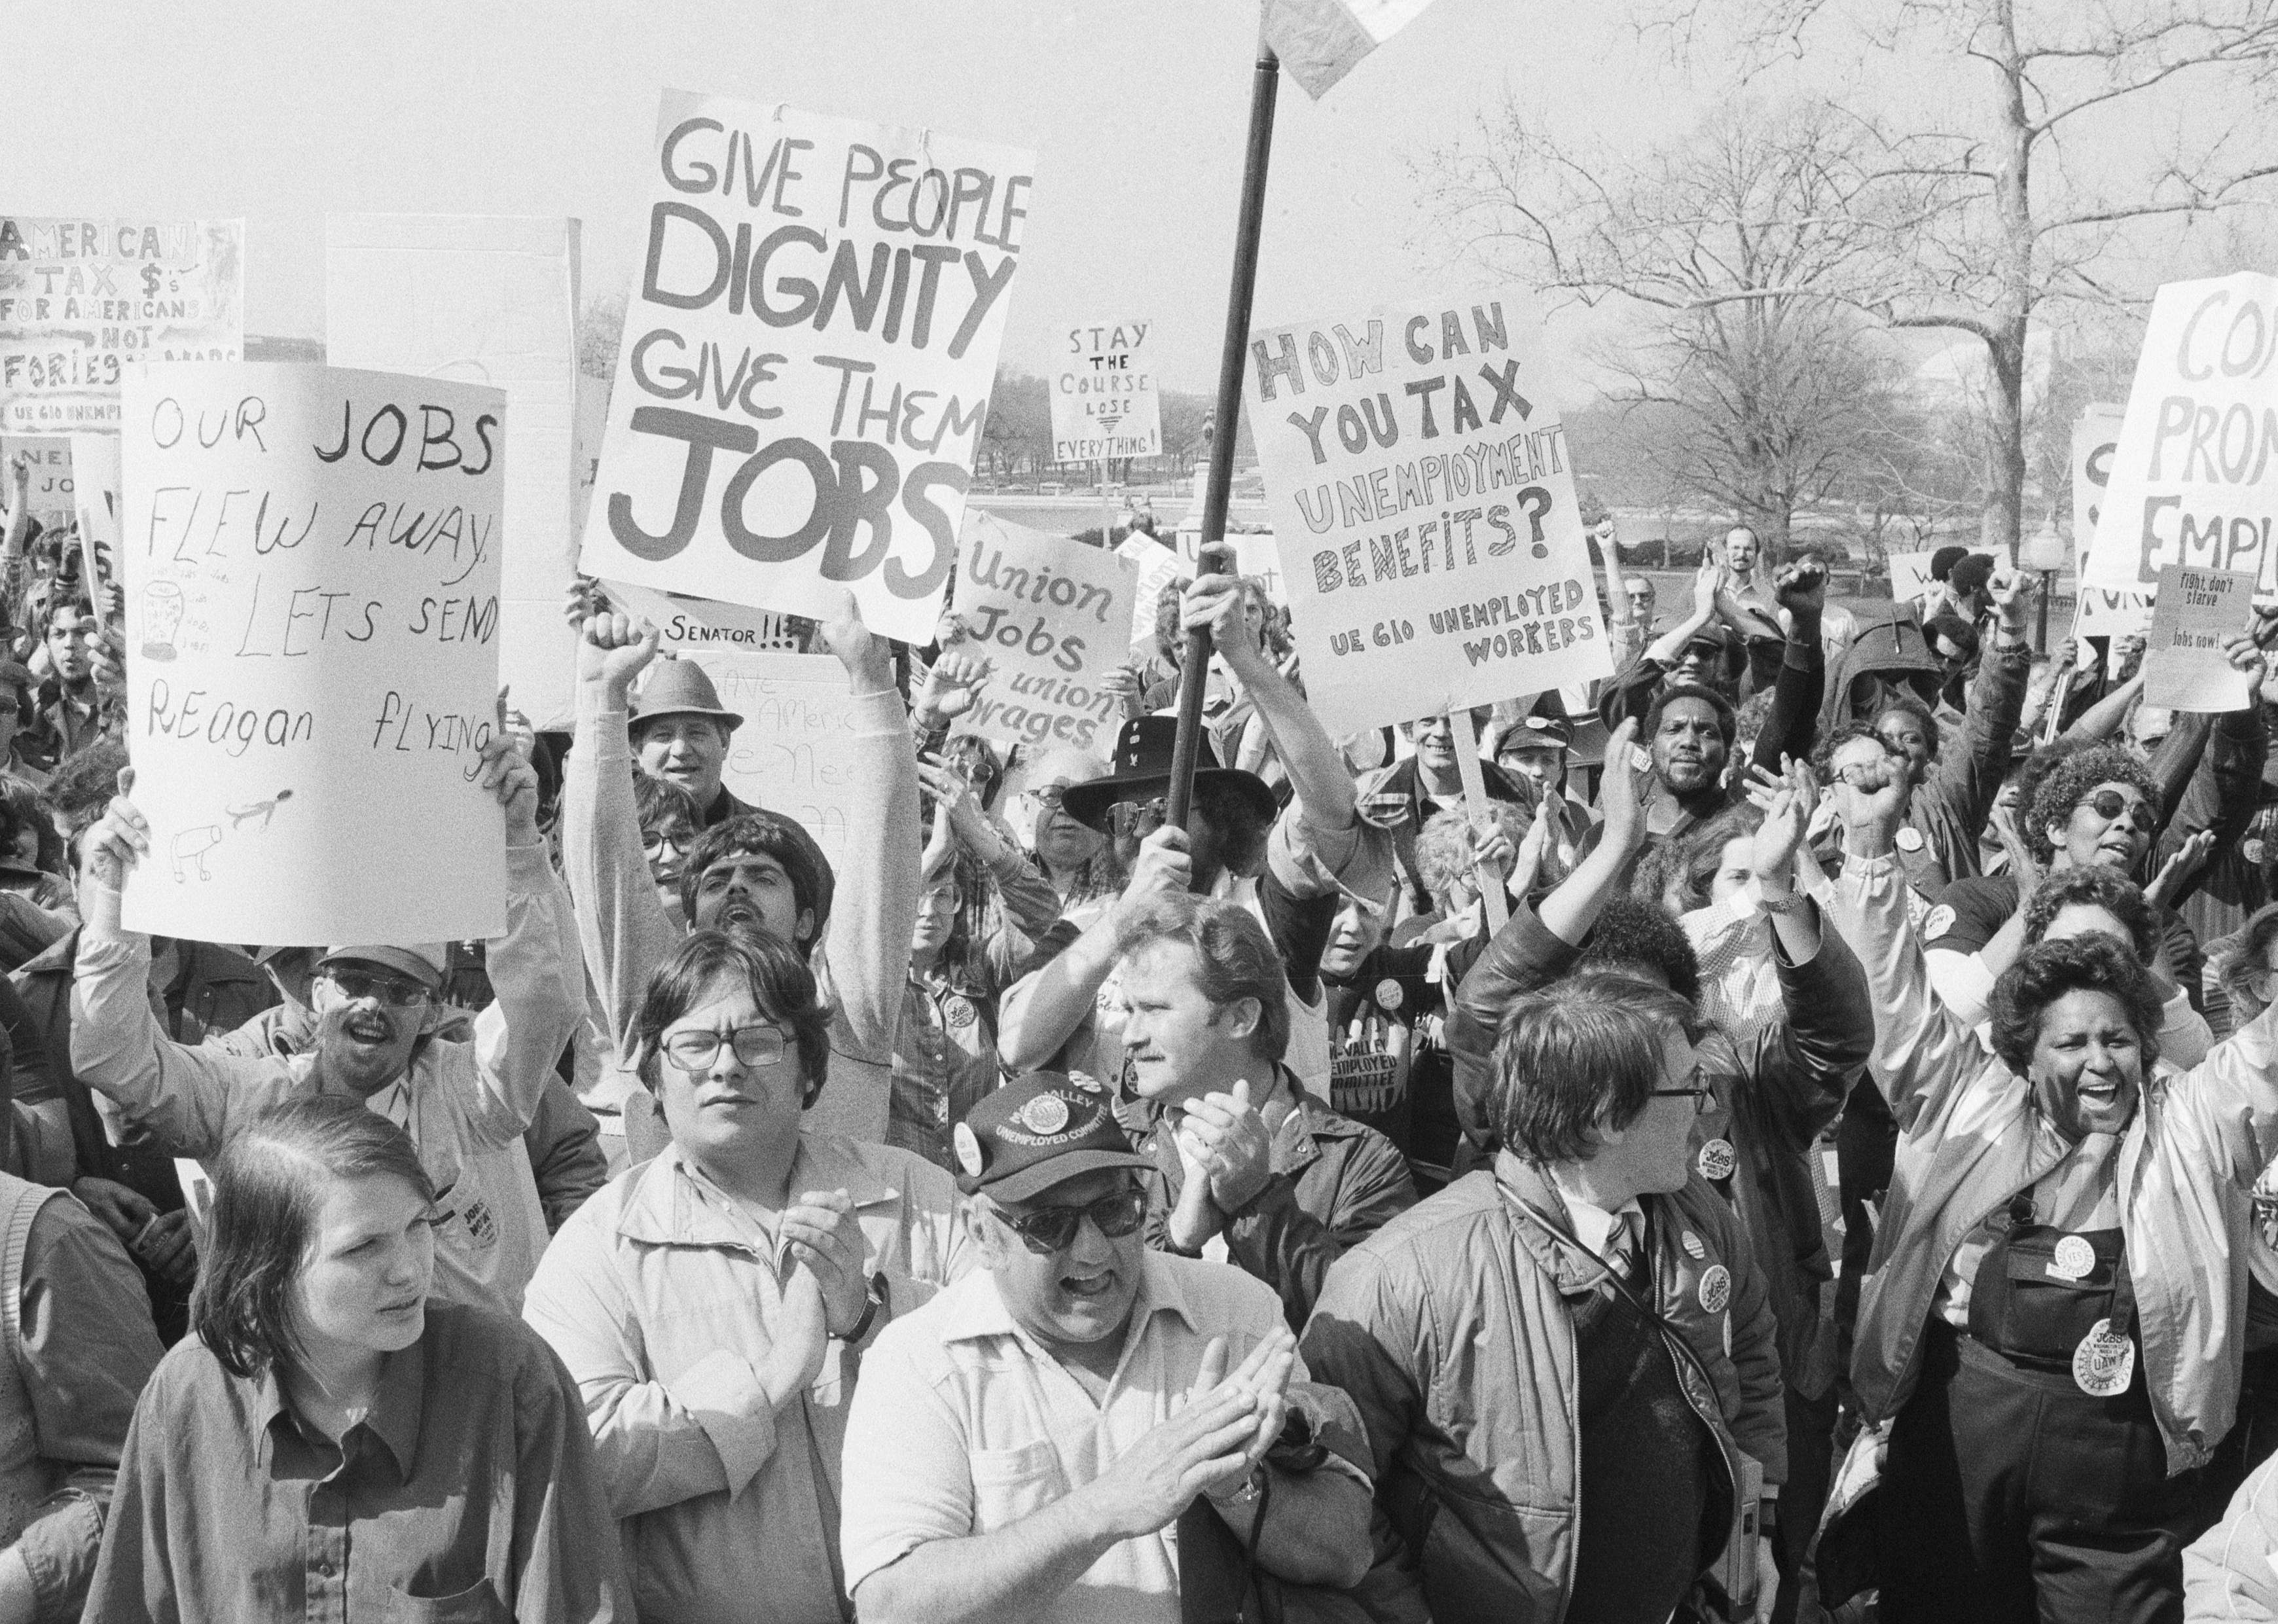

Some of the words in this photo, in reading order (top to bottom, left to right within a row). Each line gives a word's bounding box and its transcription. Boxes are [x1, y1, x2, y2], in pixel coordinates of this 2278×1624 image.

[661, 117, 814, 217] GIVE
[839, 144, 1032, 254] PEOPLE
[0, 221, 190, 261] AMERICAN
[35, 263, 118, 296] TAX
[642, 201, 1017, 359] DIGNITY
[0, 298, 50, 321] FOR
[65, 297, 198, 320] AMERICANS
[101, 325, 152, 349] NOT
[1070, 324, 1147, 353] STAY
[1251, 320, 1383, 402] HOW
[1405, 302, 1508, 365] CAN
[2177, 290, 2278, 381] CO
[1060, 372, 1148, 393] COURSE
[1090, 355, 1129, 370] THE
[15, 406, 33, 420] UE
[630, 329, 787, 420] GIVE
[813, 355, 985, 465] THEM
[1086, 399, 1130, 415] LOSE
[1286, 393, 1398, 464] YOU
[1404, 359, 1532, 440] TAX
[152, 396, 267, 452] OUR
[313, 400, 498, 475] JOBS
[608, 406, 973, 600] JOBS
[148, 486, 317, 564] FLEW
[2137, 496, 2278, 596] EMPL
[969, 540, 1112, 622] Union
[2180, 572, 2205, 592] fight,
[2209, 575, 2233, 592] don't
[2186, 590, 2217, 606] starve
[236, 573, 382, 657] LETS
[409, 594, 499, 644] SEND
[1330, 629, 1365, 655] UE
[1429, 579, 1583, 634] UNEMPLOYED
[967, 605, 1086, 672] Jobs
[1463, 615, 1594, 666] WORKERS
[2172, 627, 2192, 647] jobs
[2197, 633, 2220, 649] now!
[1011, 672, 1114, 723] union
[1044, 1090, 1093, 1108] ALLEY
[996, 1125, 1068, 1146] UNEMPLOYED
[1706, 1149, 1730, 1166] JOBS
[1707, 1276, 1726, 1303] JOBS
[2095, 1356, 2116, 1371] UAW
